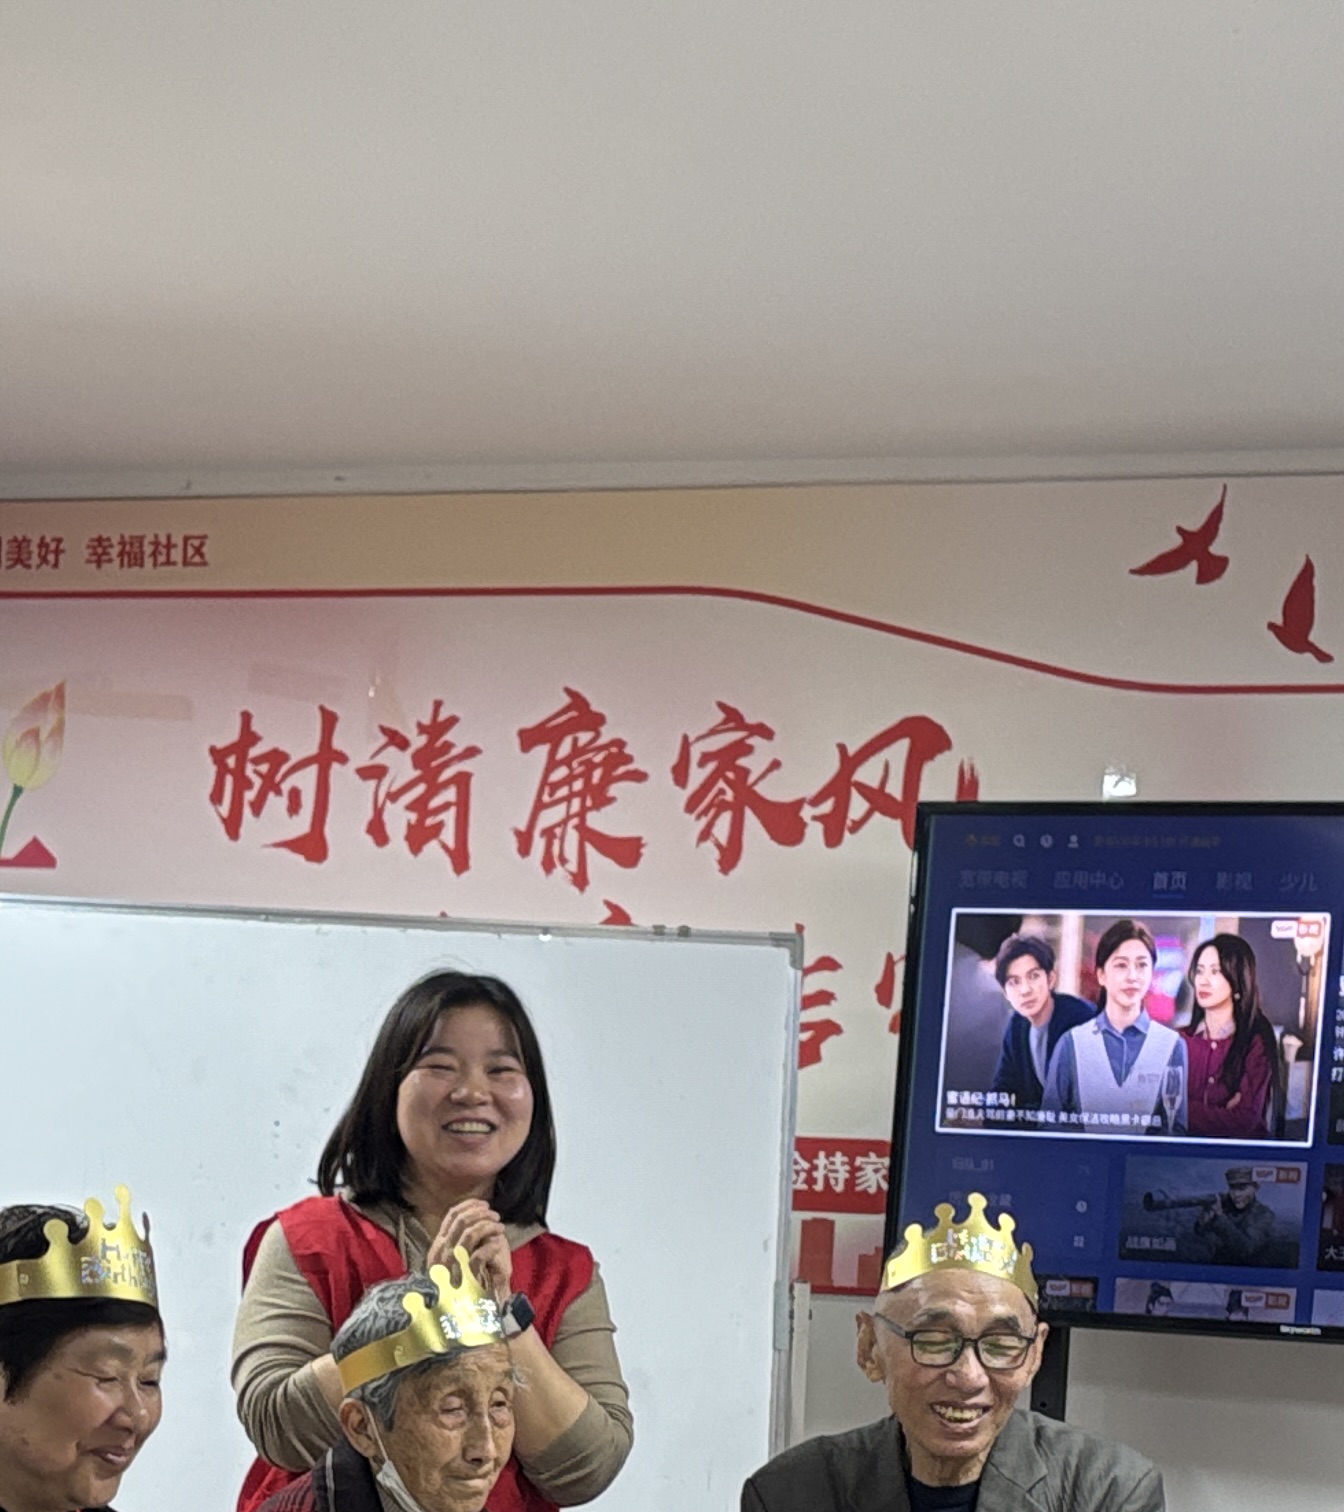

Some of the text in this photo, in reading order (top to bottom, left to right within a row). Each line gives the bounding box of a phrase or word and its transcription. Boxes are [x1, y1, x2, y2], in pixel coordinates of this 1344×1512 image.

[85, 531, 212, 571] 幸福社区
[208, 686, 979, 893] 树清廉家风
[1152, 870, 1188, 891] 首页
[1214, 871, 1254, 891] 影视
[1278, 871, 1318, 893] 少儿
